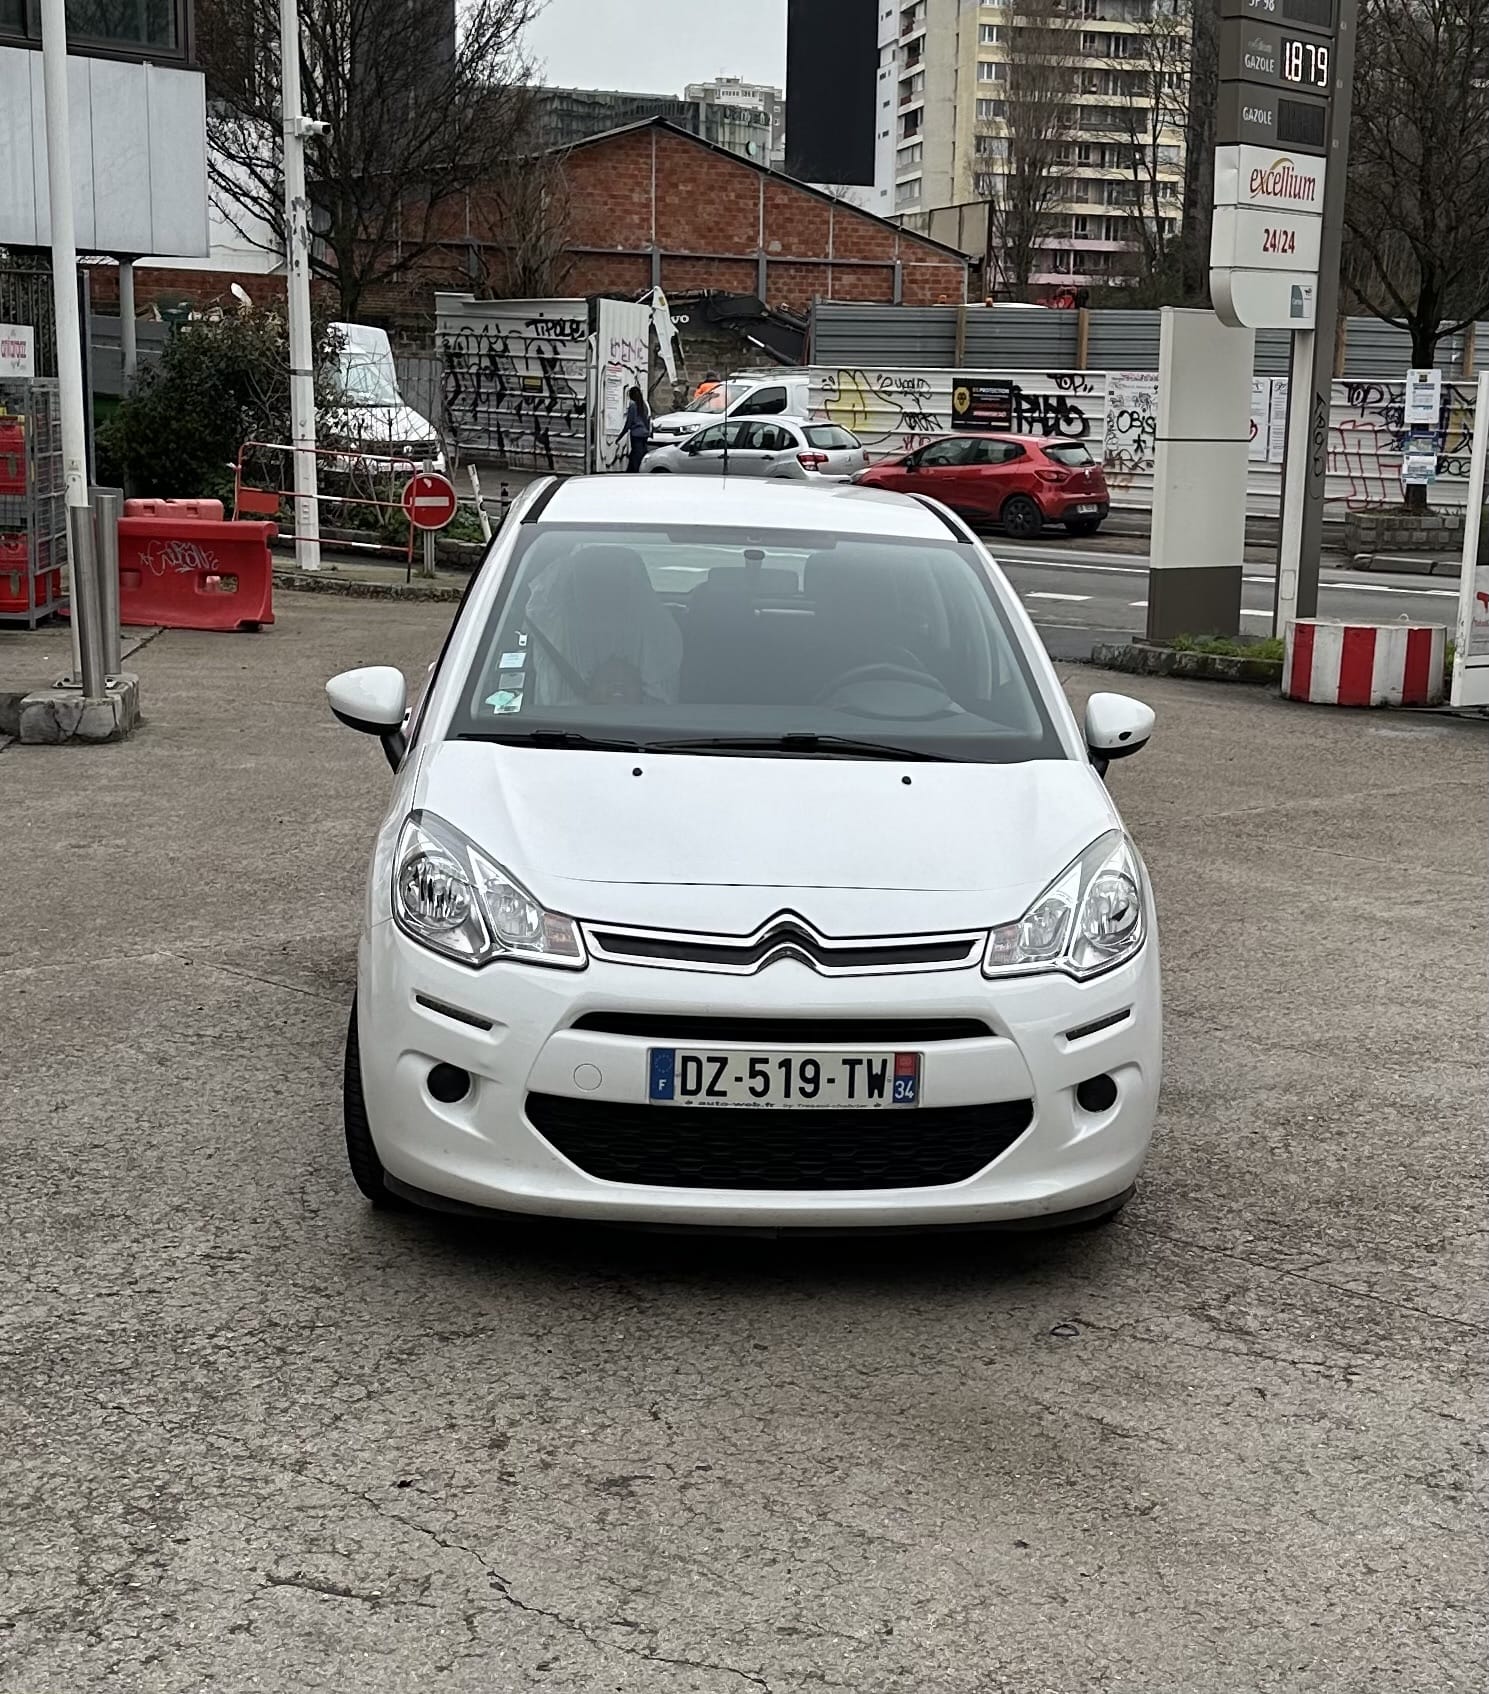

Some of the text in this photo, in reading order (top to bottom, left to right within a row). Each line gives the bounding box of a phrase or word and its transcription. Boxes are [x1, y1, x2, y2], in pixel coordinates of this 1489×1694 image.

[1244, 53, 1275, 73] GAZOLE
[1242, 106, 1272, 126] GAZOLE
[1249, 165, 1316, 202] excellium
[1262, 228, 1296, 254] 24/24
[658, 1079, 666, 1091] F
[680, 1055, 888, 1100] DZ-519-TW
[894, 1080, 914, 1099] 34
